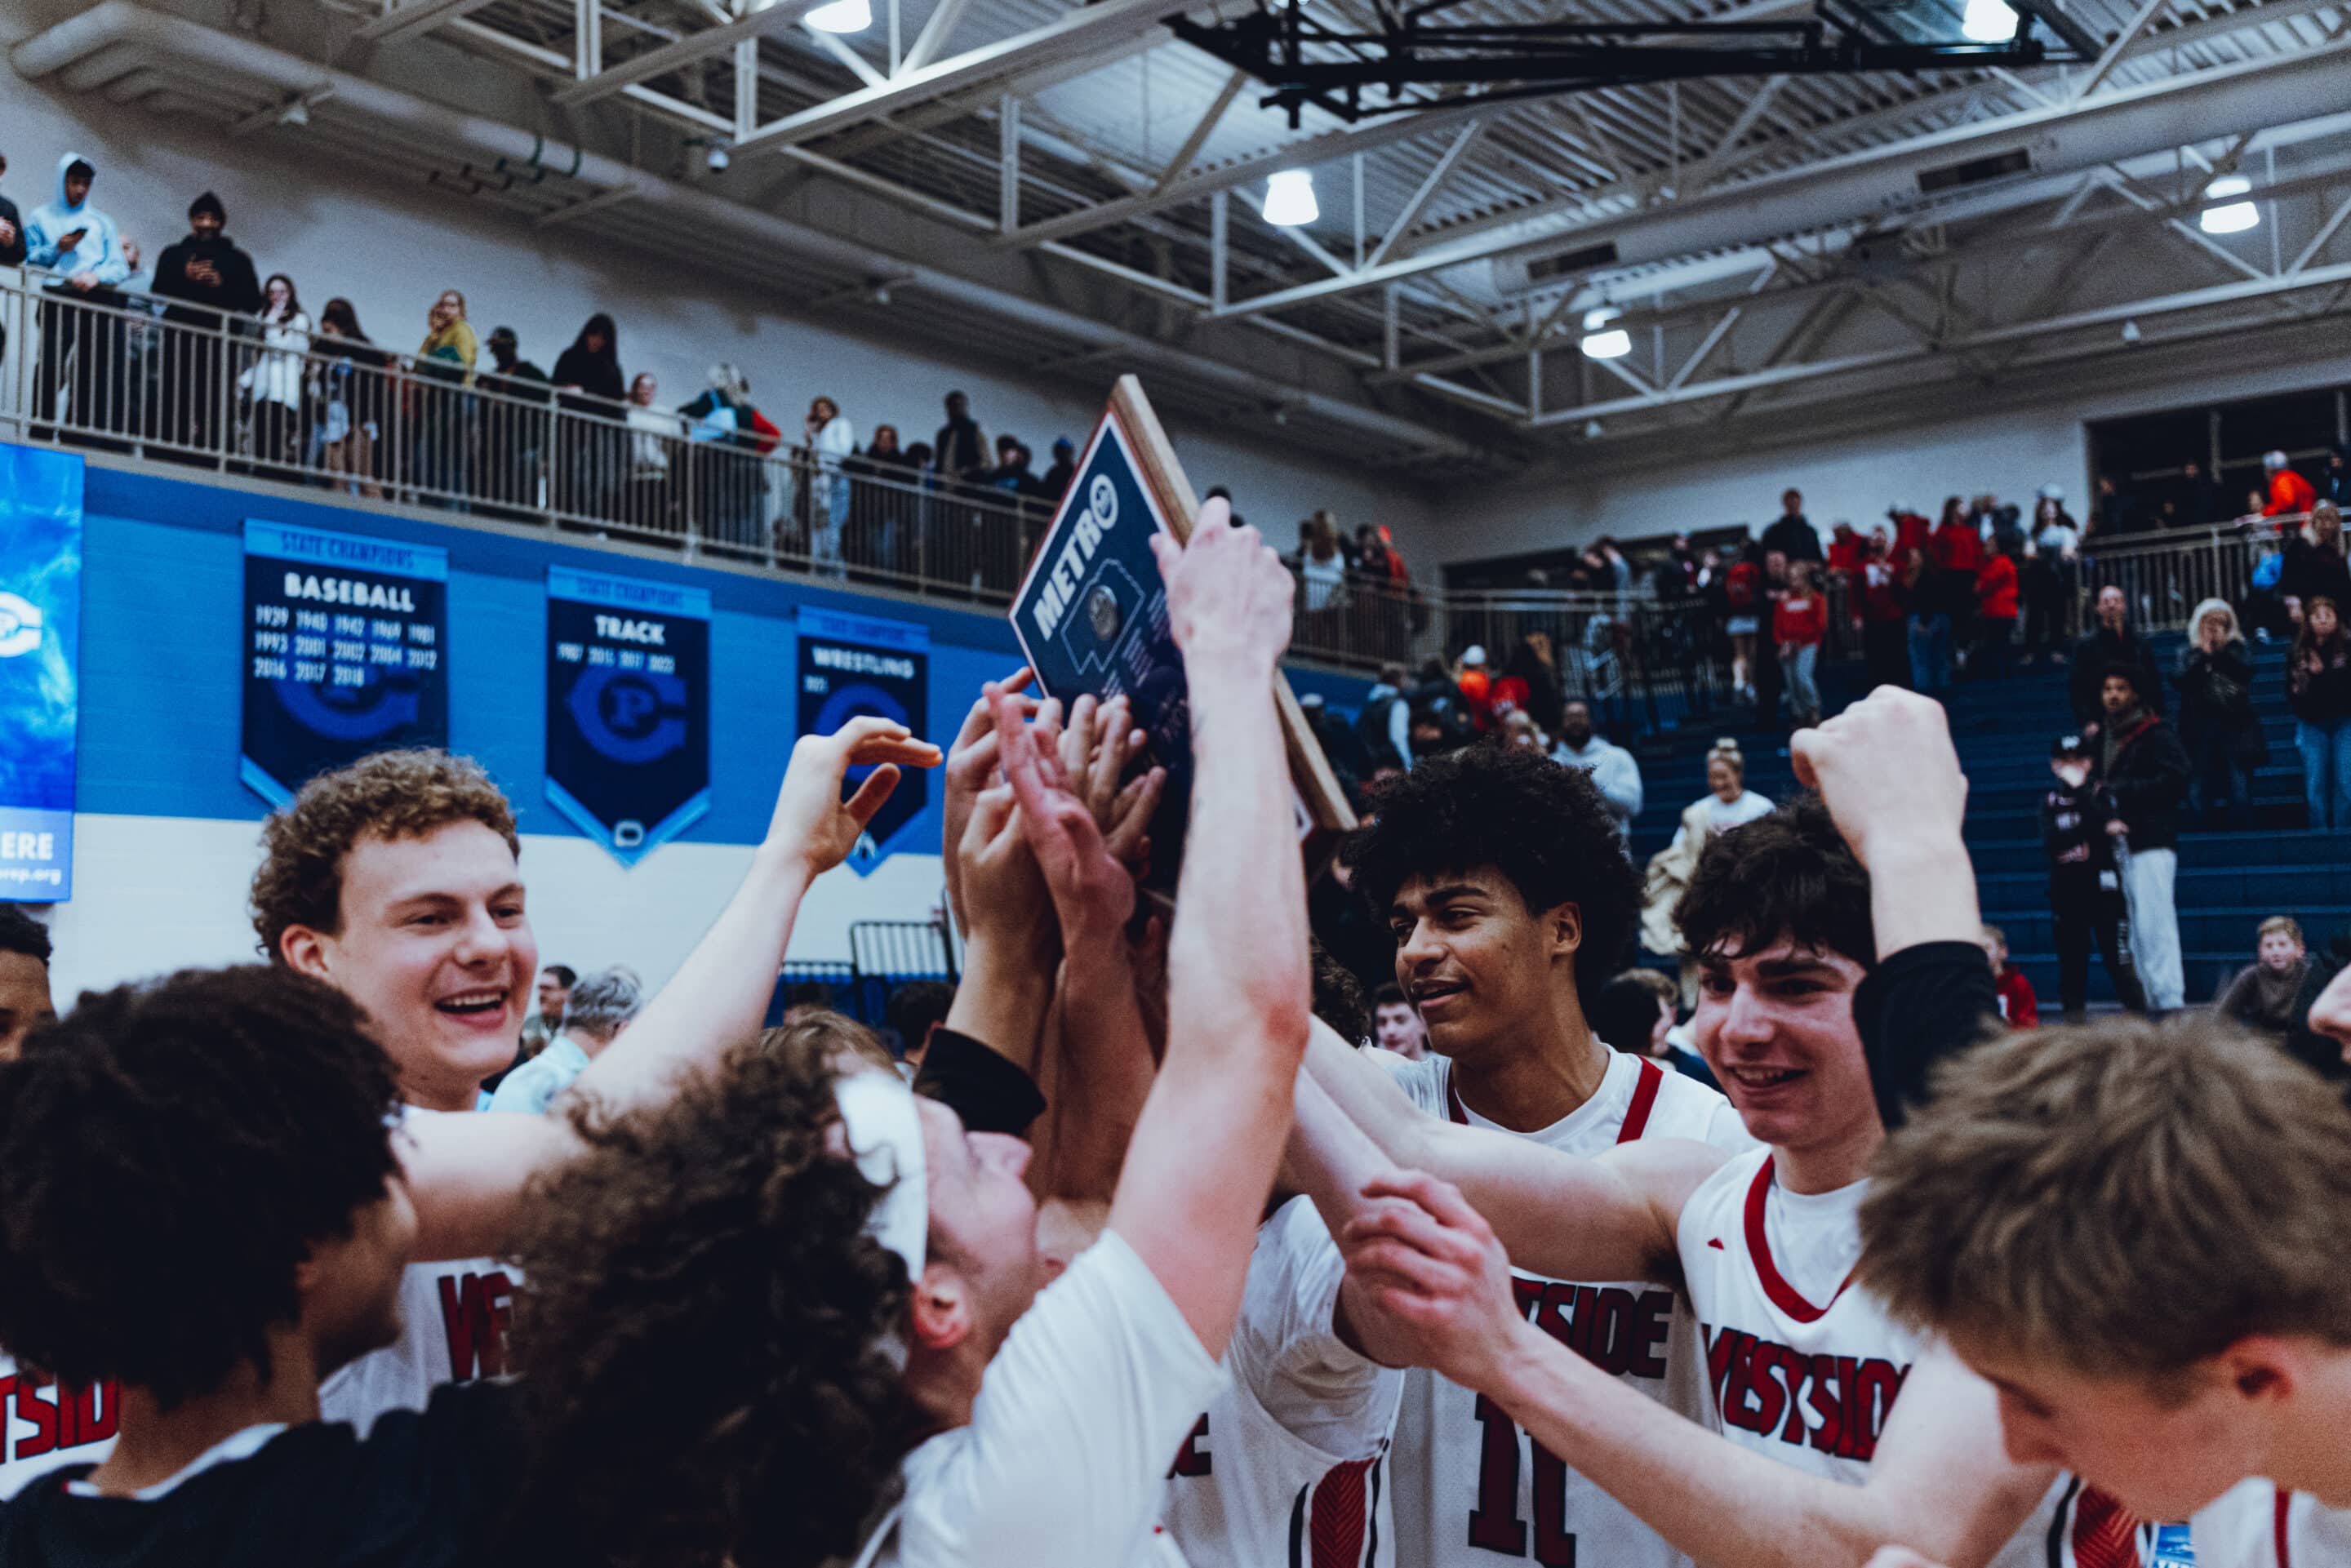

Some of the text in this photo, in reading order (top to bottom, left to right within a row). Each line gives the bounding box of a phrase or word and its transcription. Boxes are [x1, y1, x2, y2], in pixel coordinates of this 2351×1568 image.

[1033, 473, 1119, 642] METRO
[285, 571, 416, 612] BASEBALL
[256, 604, 289, 627] 1939
[594, 613, 666, 646] TRACK
[811, 646, 915, 680] WRESTLING
[1701, 1323, 1913, 1463] WESTSID
